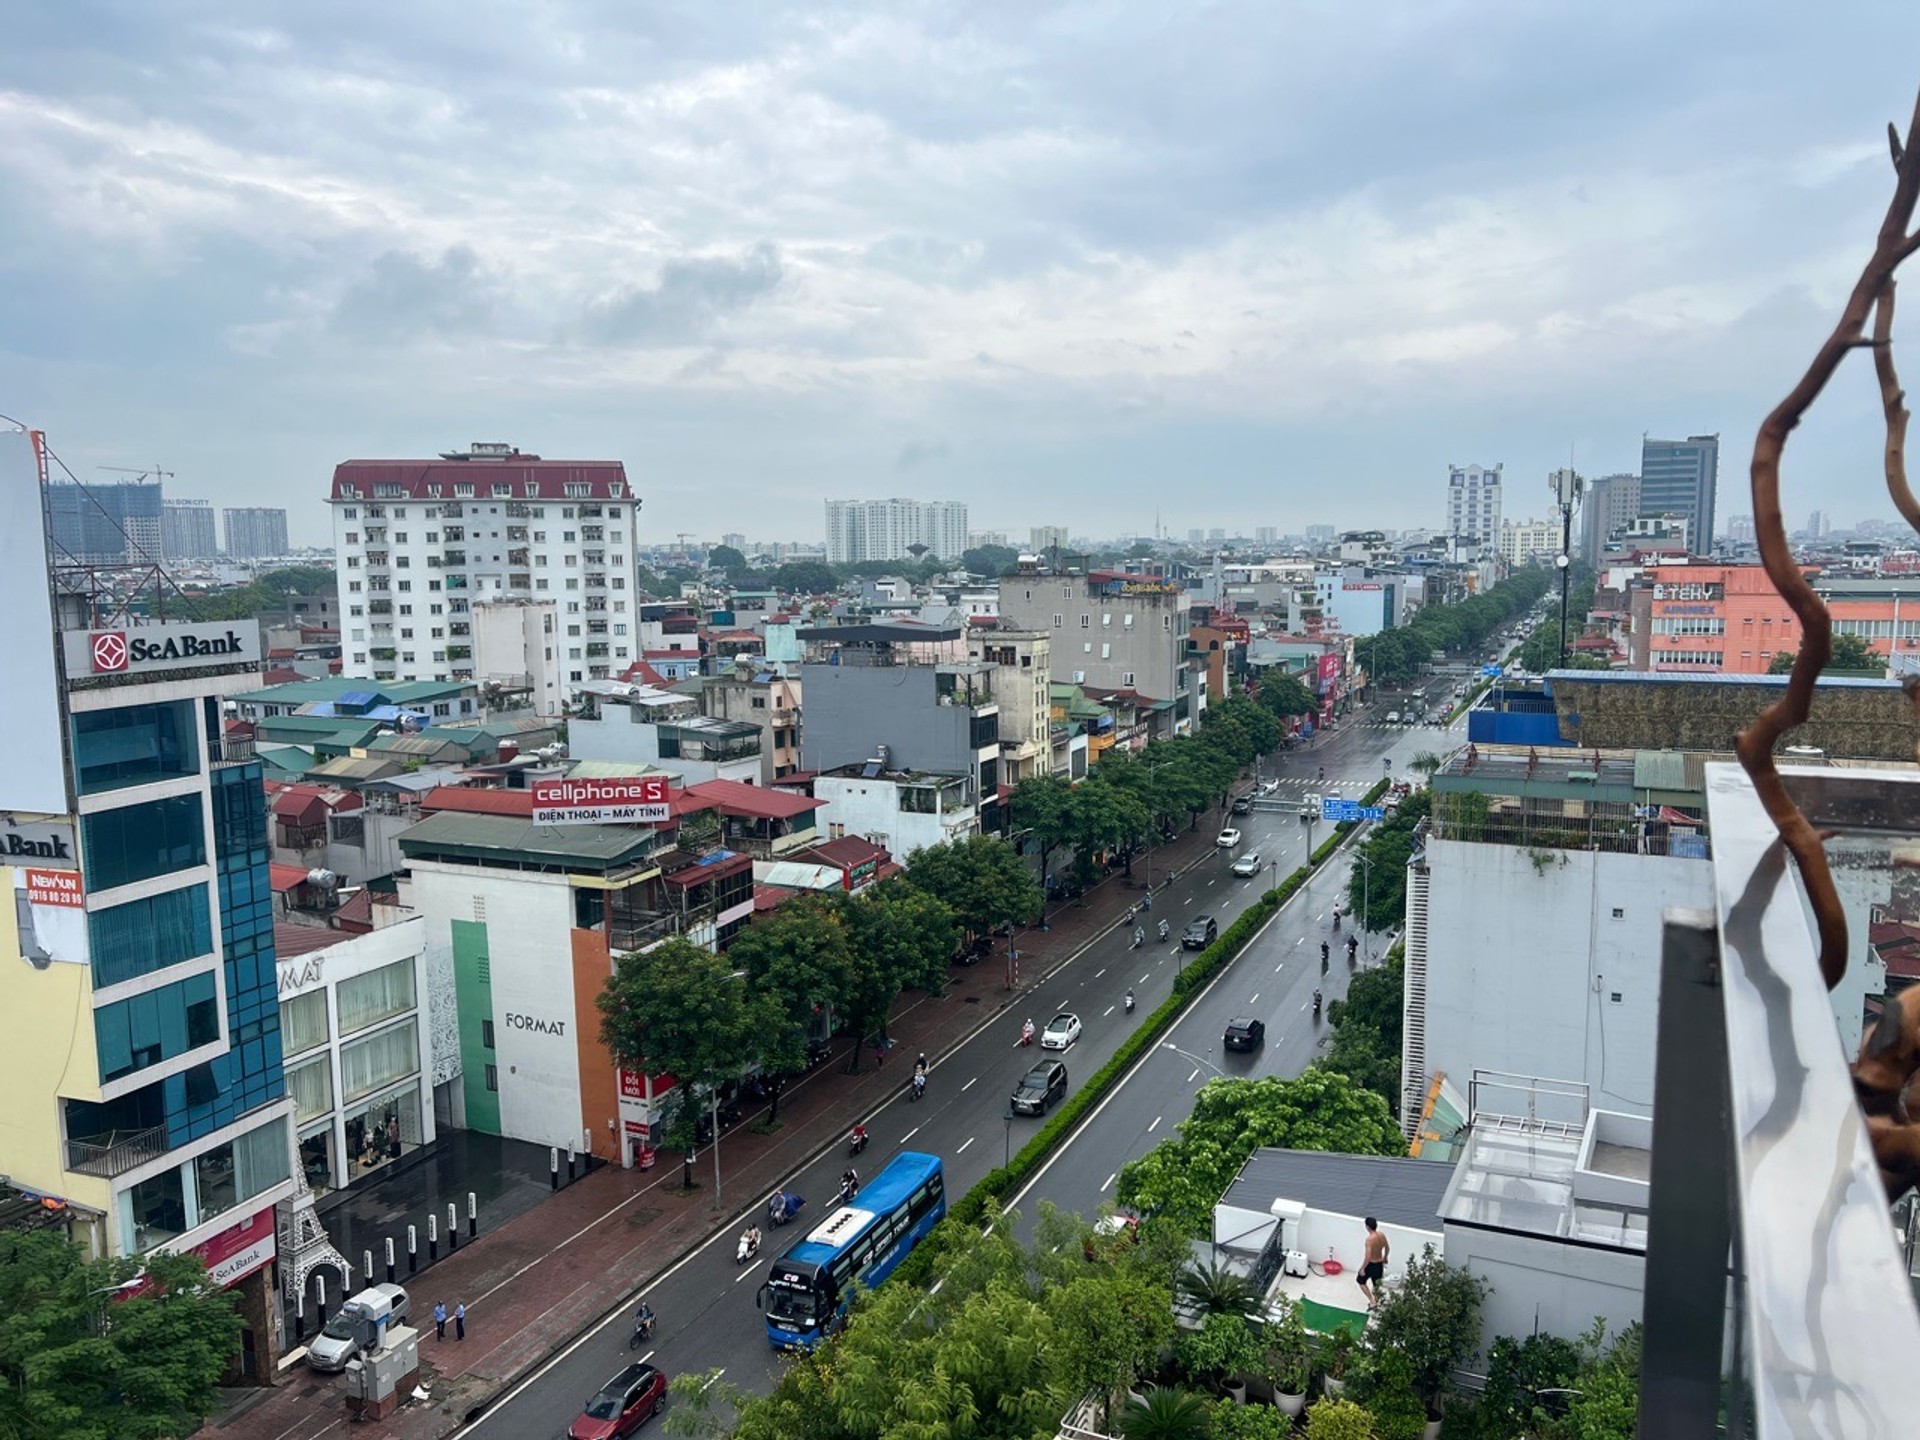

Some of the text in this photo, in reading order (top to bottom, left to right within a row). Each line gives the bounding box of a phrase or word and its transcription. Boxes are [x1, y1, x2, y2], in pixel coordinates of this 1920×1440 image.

[130, 631, 243, 662] SeABank
[538, 810, 565, 823] ĐIỆN
[568, 809, 601, 822] THOẠI
[613, 806, 636, 819] MÁY
[639, 805, 665, 817] TÍNH
[61, 893, 70, 903] 20
[505, 1013, 565, 1036] FORMAT
[216, 1249, 260, 1281] SeABank
